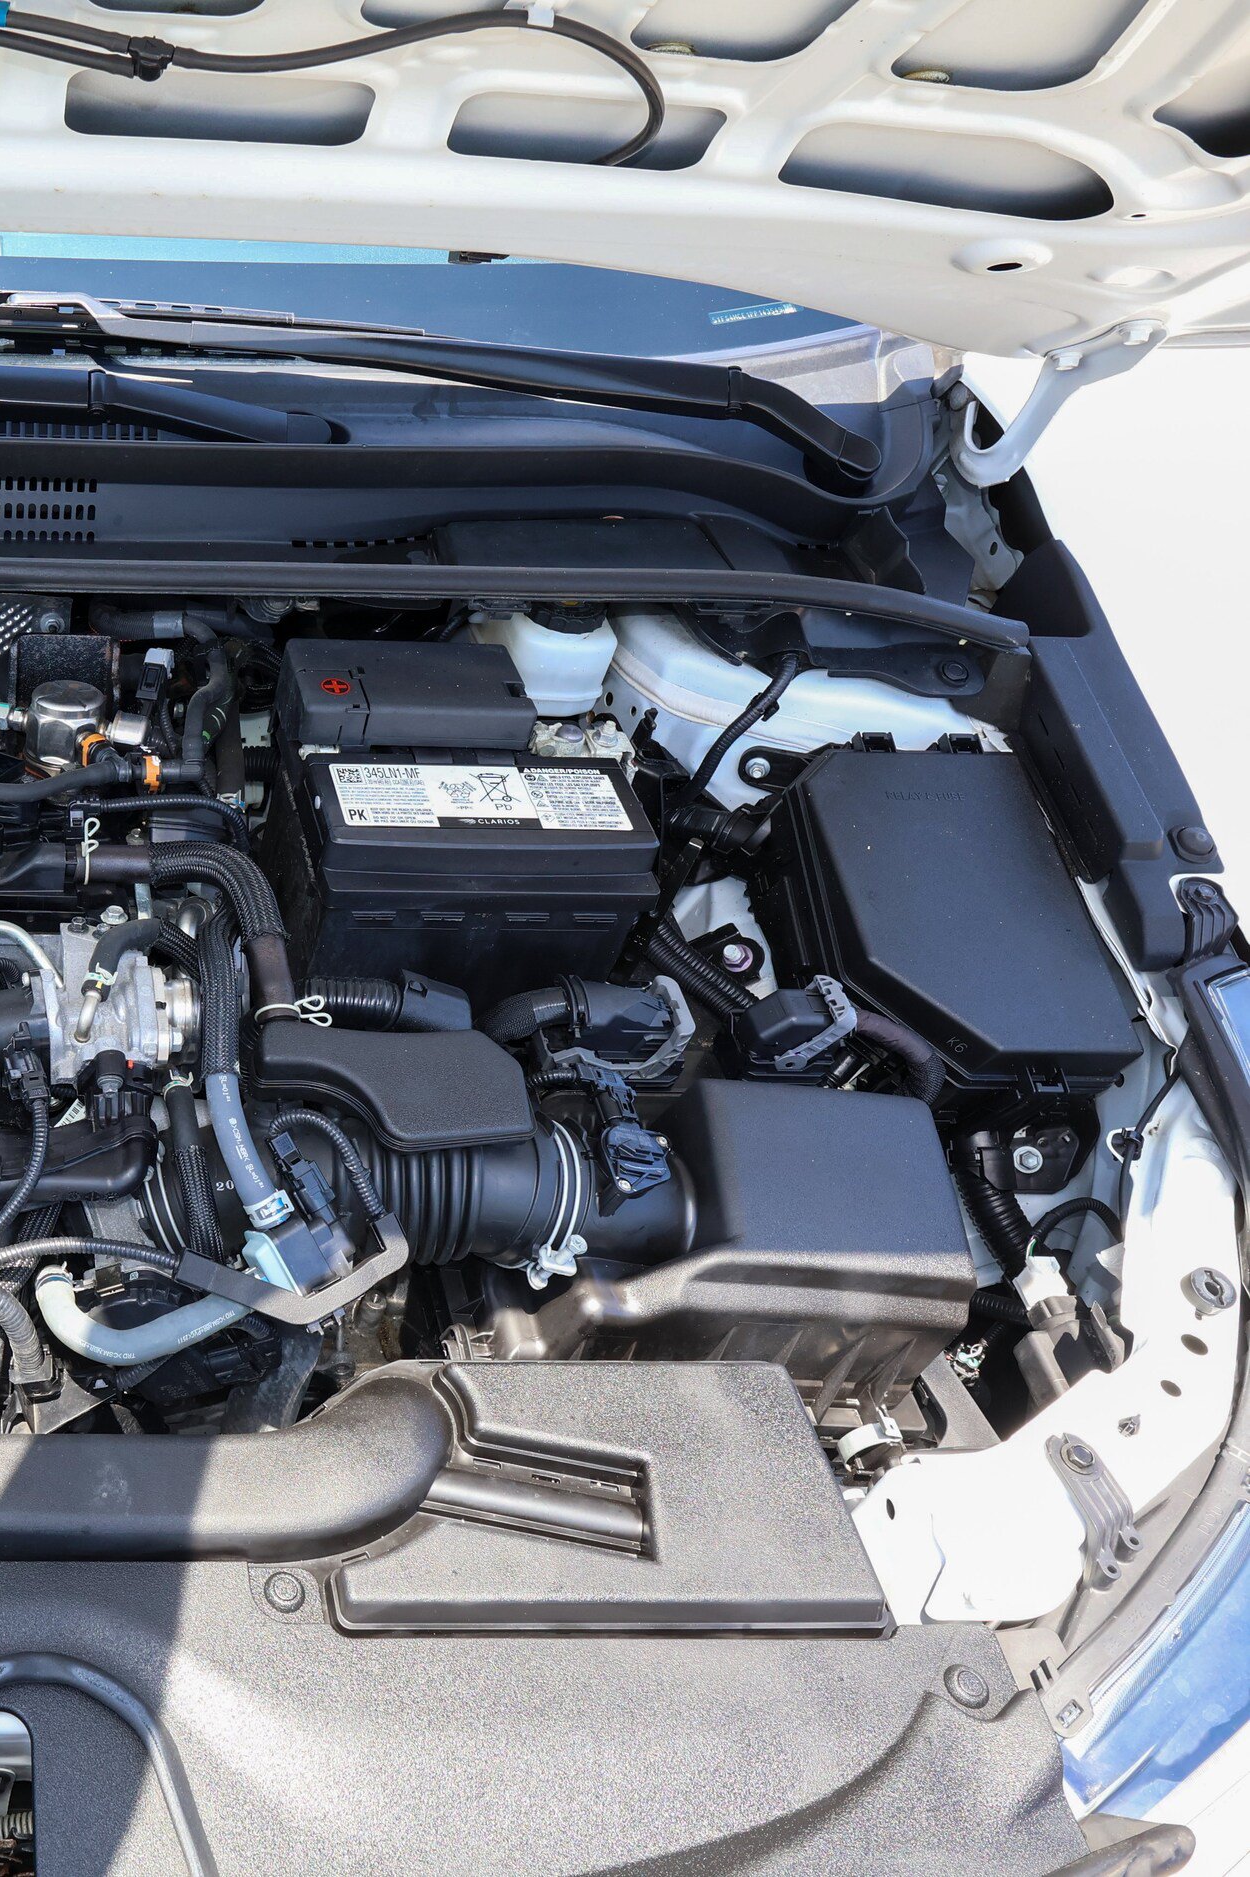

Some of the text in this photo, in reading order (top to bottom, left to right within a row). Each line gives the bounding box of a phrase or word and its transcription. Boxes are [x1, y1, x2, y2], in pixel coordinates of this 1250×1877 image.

[363, 767, 420, 779] 345LN1-MF
[885, 791, 921, 801] RELAY
[935, 792, 965, 801] FUSE
[494, 803, 513, 811] Pb
[348, 809, 367, 821] PK
[946, 1036, 968, 1053] K6
